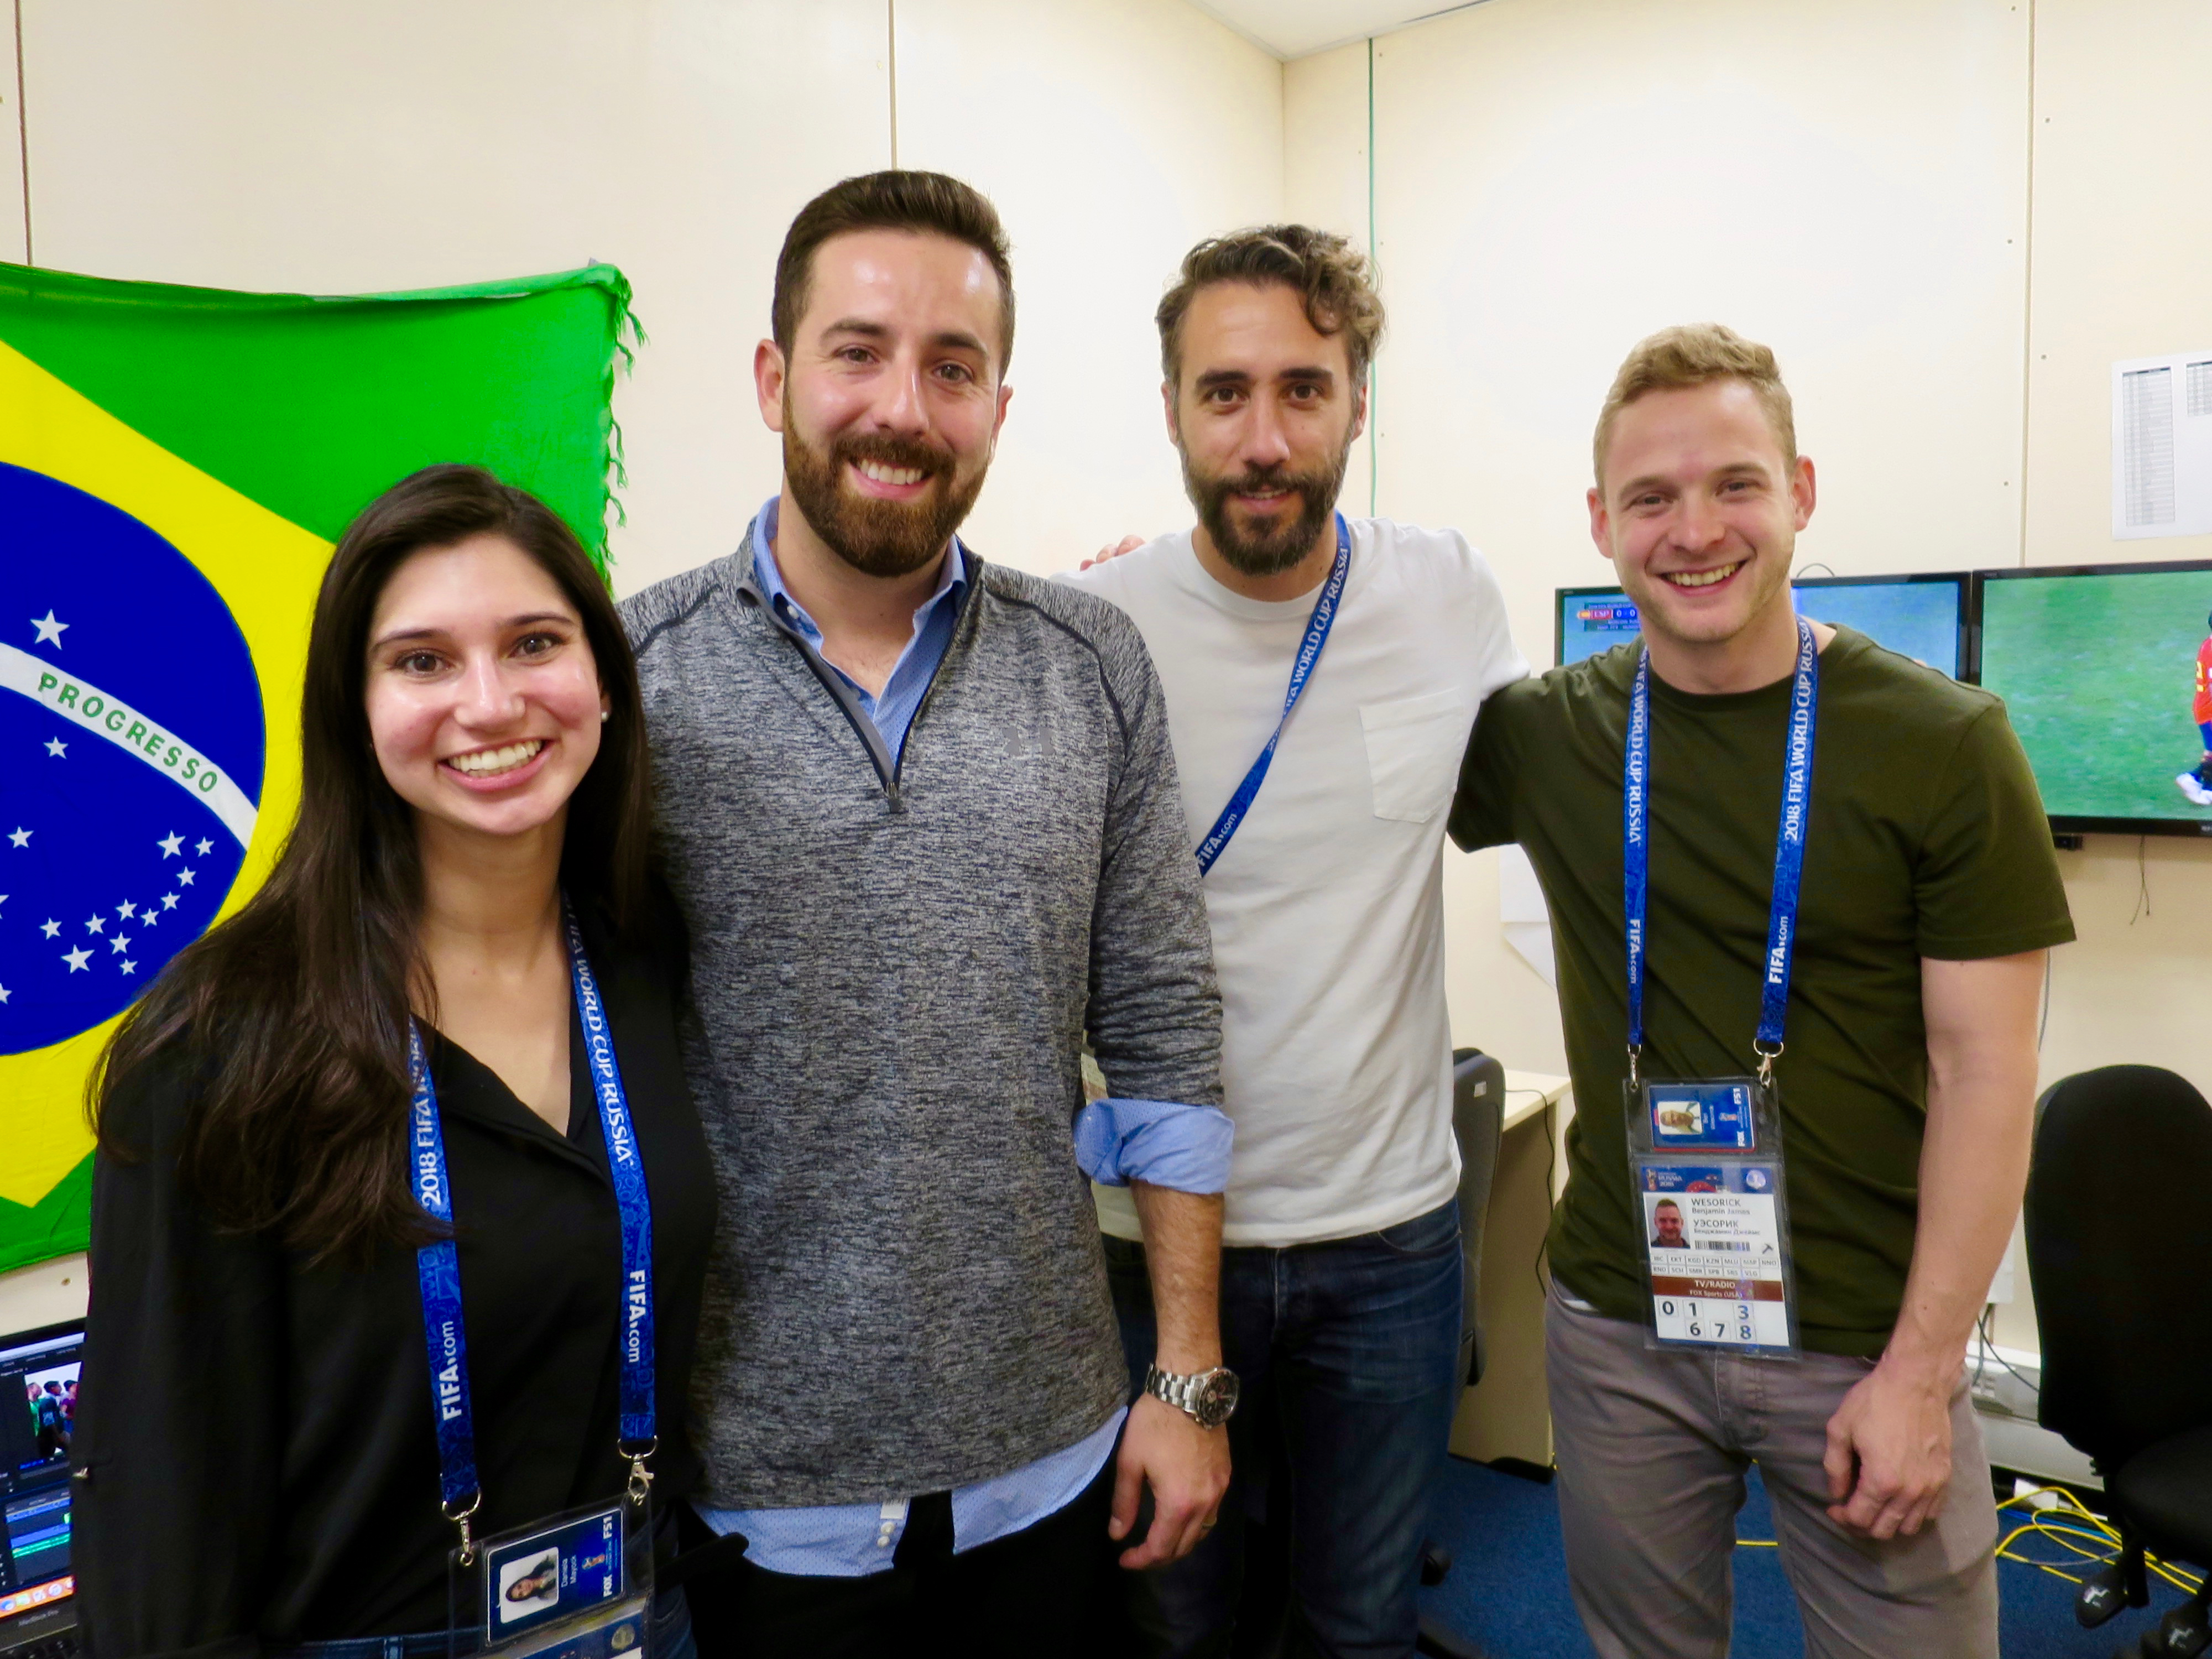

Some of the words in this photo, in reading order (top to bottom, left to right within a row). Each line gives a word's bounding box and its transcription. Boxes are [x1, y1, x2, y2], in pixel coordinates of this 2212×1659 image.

[1293, 630, 1321, 684] WORLD
[1314, 599, 1333, 632] CUP
[1327, 547, 1348, 600] RUSSIA
[1800, 621, 1813, 672] RUSSIA
[1796, 674, 1812, 707] CUP
[38, 672, 218, 792] PROGRESSO
[1631, 695, 1644, 748] WORLD
[1792, 709, 1809, 766] WORLD
[1631, 750, 1642, 782] CUP
[1788, 770, 1804, 802] FIFA
[1629, 785, 1641, 844] RUSSIA
[1785, 805, 1801, 841] 2018
[1630, 919, 1641, 984] FIFA.com
[1768, 916, 1788, 984] FIFA.com
[577, 960, 602, 1032] WORLD
[592, 1035, 613, 1078] CUP
[1733, 1087, 1742, 1105] FS1
[415, 1097, 435, 1147] FIFA
[602, 1082, 632, 1164] RUSSIA
[419, 1151, 442, 1207] 2018
[1691, 1198, 1741, 1207] WESORICK
[1693, 1219, 1739, 1228] УЭСОРИК
[1694, 1279, 1736, 1289] TV/RADIO
[629, 1270, 646, 1363] FIFA.com
[1662, 1301, 1674, 1315] 0
[1688, 1302, 1697, 1317] 1
[1738, 1305, 1749, 1319] 3
[1690, 1322, 1701, 1336] 6
[1715, 1323, 1725, 1338] 7
[1740, 1325, 1752, 1340] 8
[439, 1321, 462, 1421] FIFA.com
[603, 1515, 613, 1540] FS1
[603, 1573, 613, 1598] FOX
